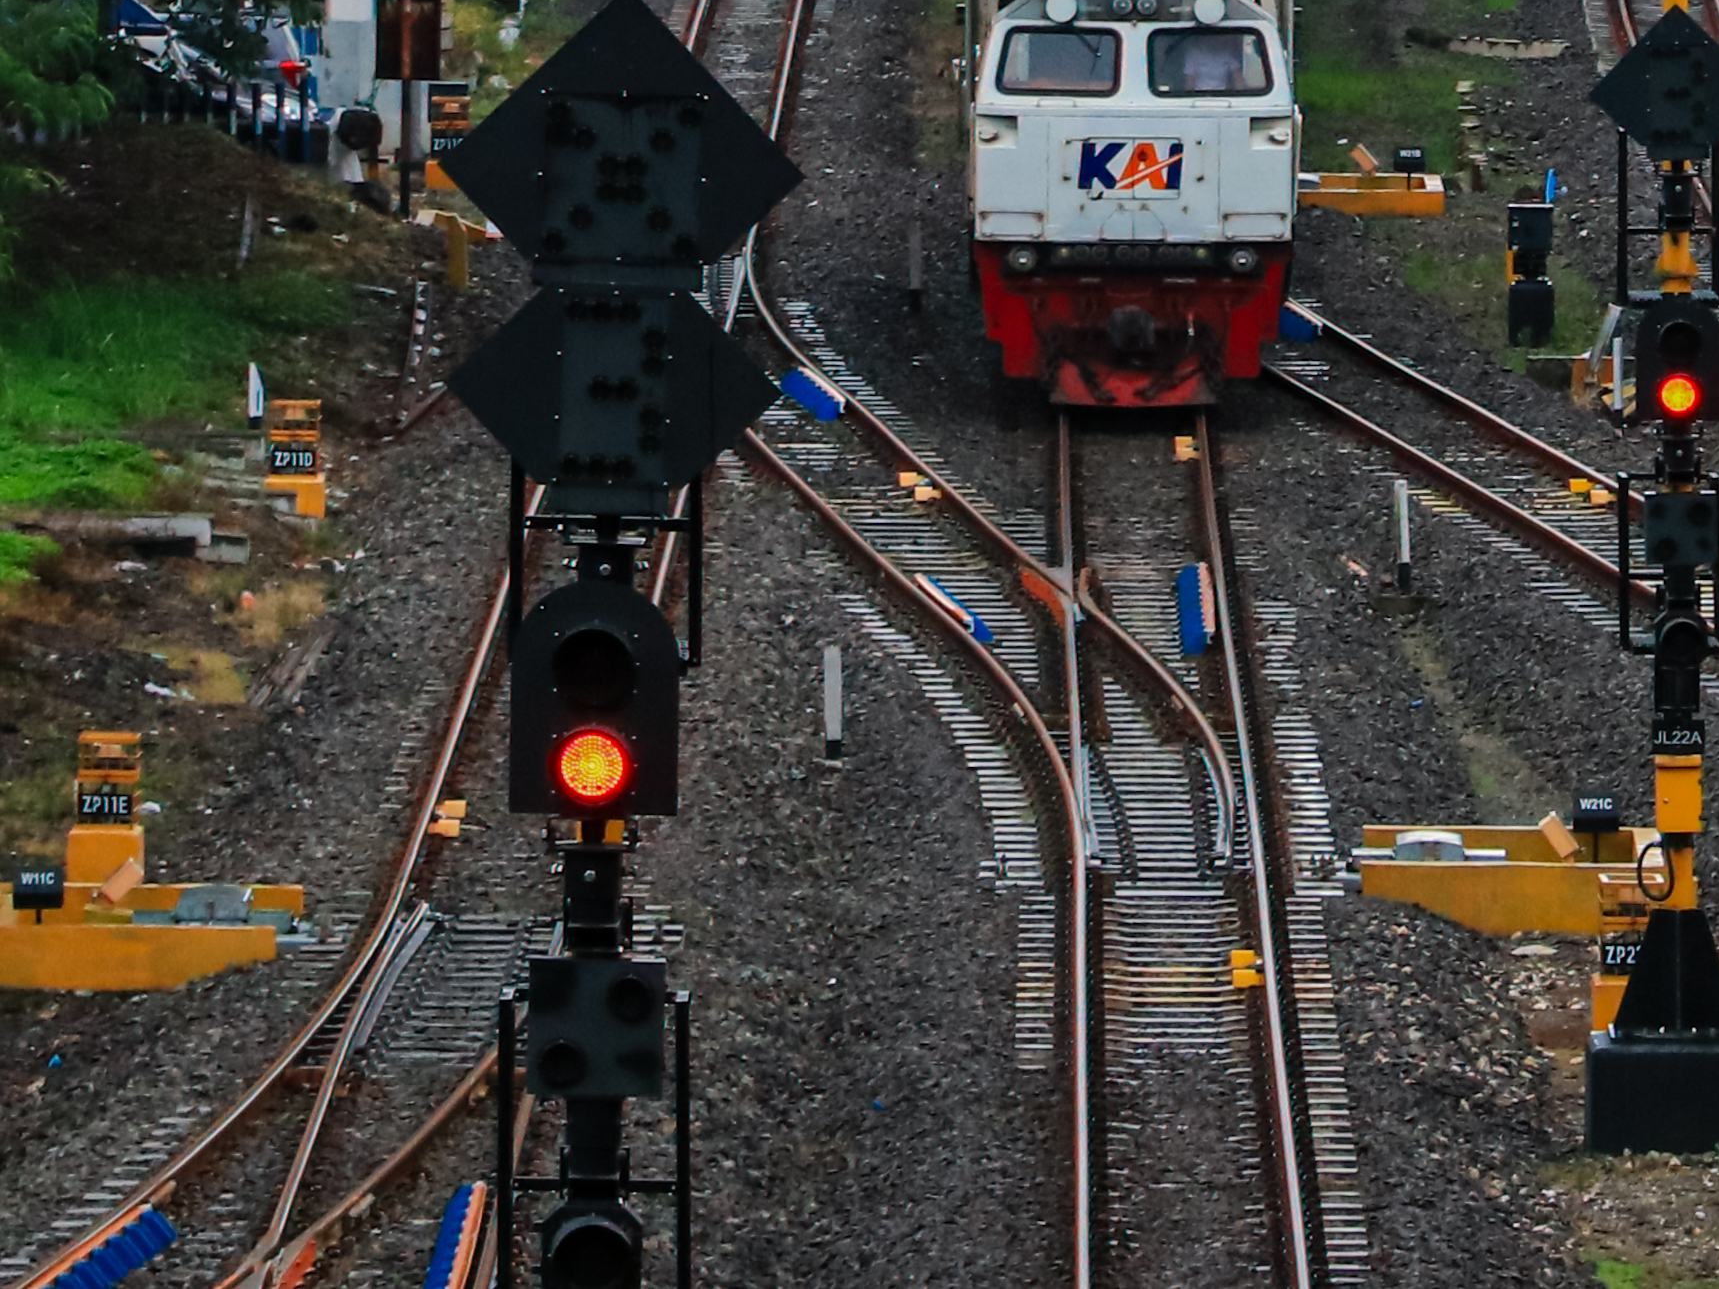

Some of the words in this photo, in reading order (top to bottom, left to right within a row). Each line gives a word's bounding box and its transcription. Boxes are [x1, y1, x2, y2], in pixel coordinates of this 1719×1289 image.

[1078, 141, 1185, 191] KAI
[273, 451, 313, 468] ZP11D
[82, 794, 129, 815] ZP11E
[1579, 797, 1613, 811] W21C
[20, 871, 56, 885] W11C
[1604, 944, 1642, 965] ZP2
